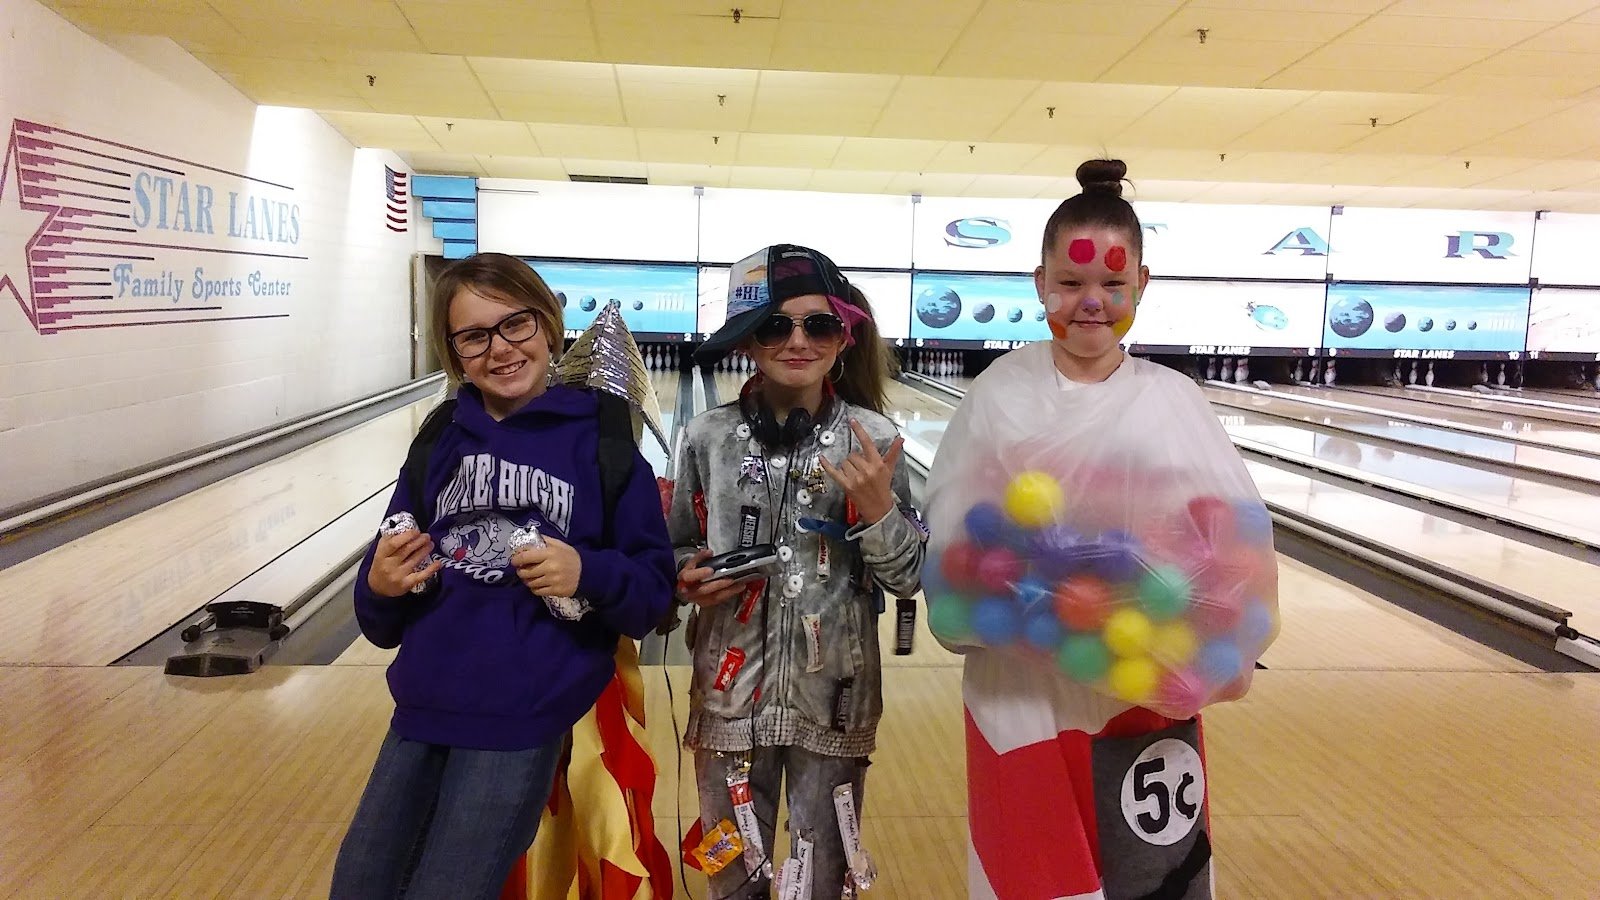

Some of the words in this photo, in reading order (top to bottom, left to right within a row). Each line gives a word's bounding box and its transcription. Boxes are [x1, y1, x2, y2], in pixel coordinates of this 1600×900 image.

[132, 171, 215, 236] STAR
[226, 190, 301, 246] LANES
[113, 263, 185, 303] Family
[191, 266, 242, 302] Sports
[247, 269, 292, 297] Center
[683, 333, 692, 342] 2
[895, 338, 904, 347] 4
[915, 338, 924, 347] 5
[983, 340, 1010, 350] STAR
[1189, 345, 1215, 354] STAR
[1217, 345, 1251, 355] LANES
[1393, 349, 1420, 358] STAR
[1422, 350, 1455, 359] LANES
[1508, 350, 1520, 360] 10
[1529, 350, 1539, 360] 11
[497, 457, 575, 538] HIGH
